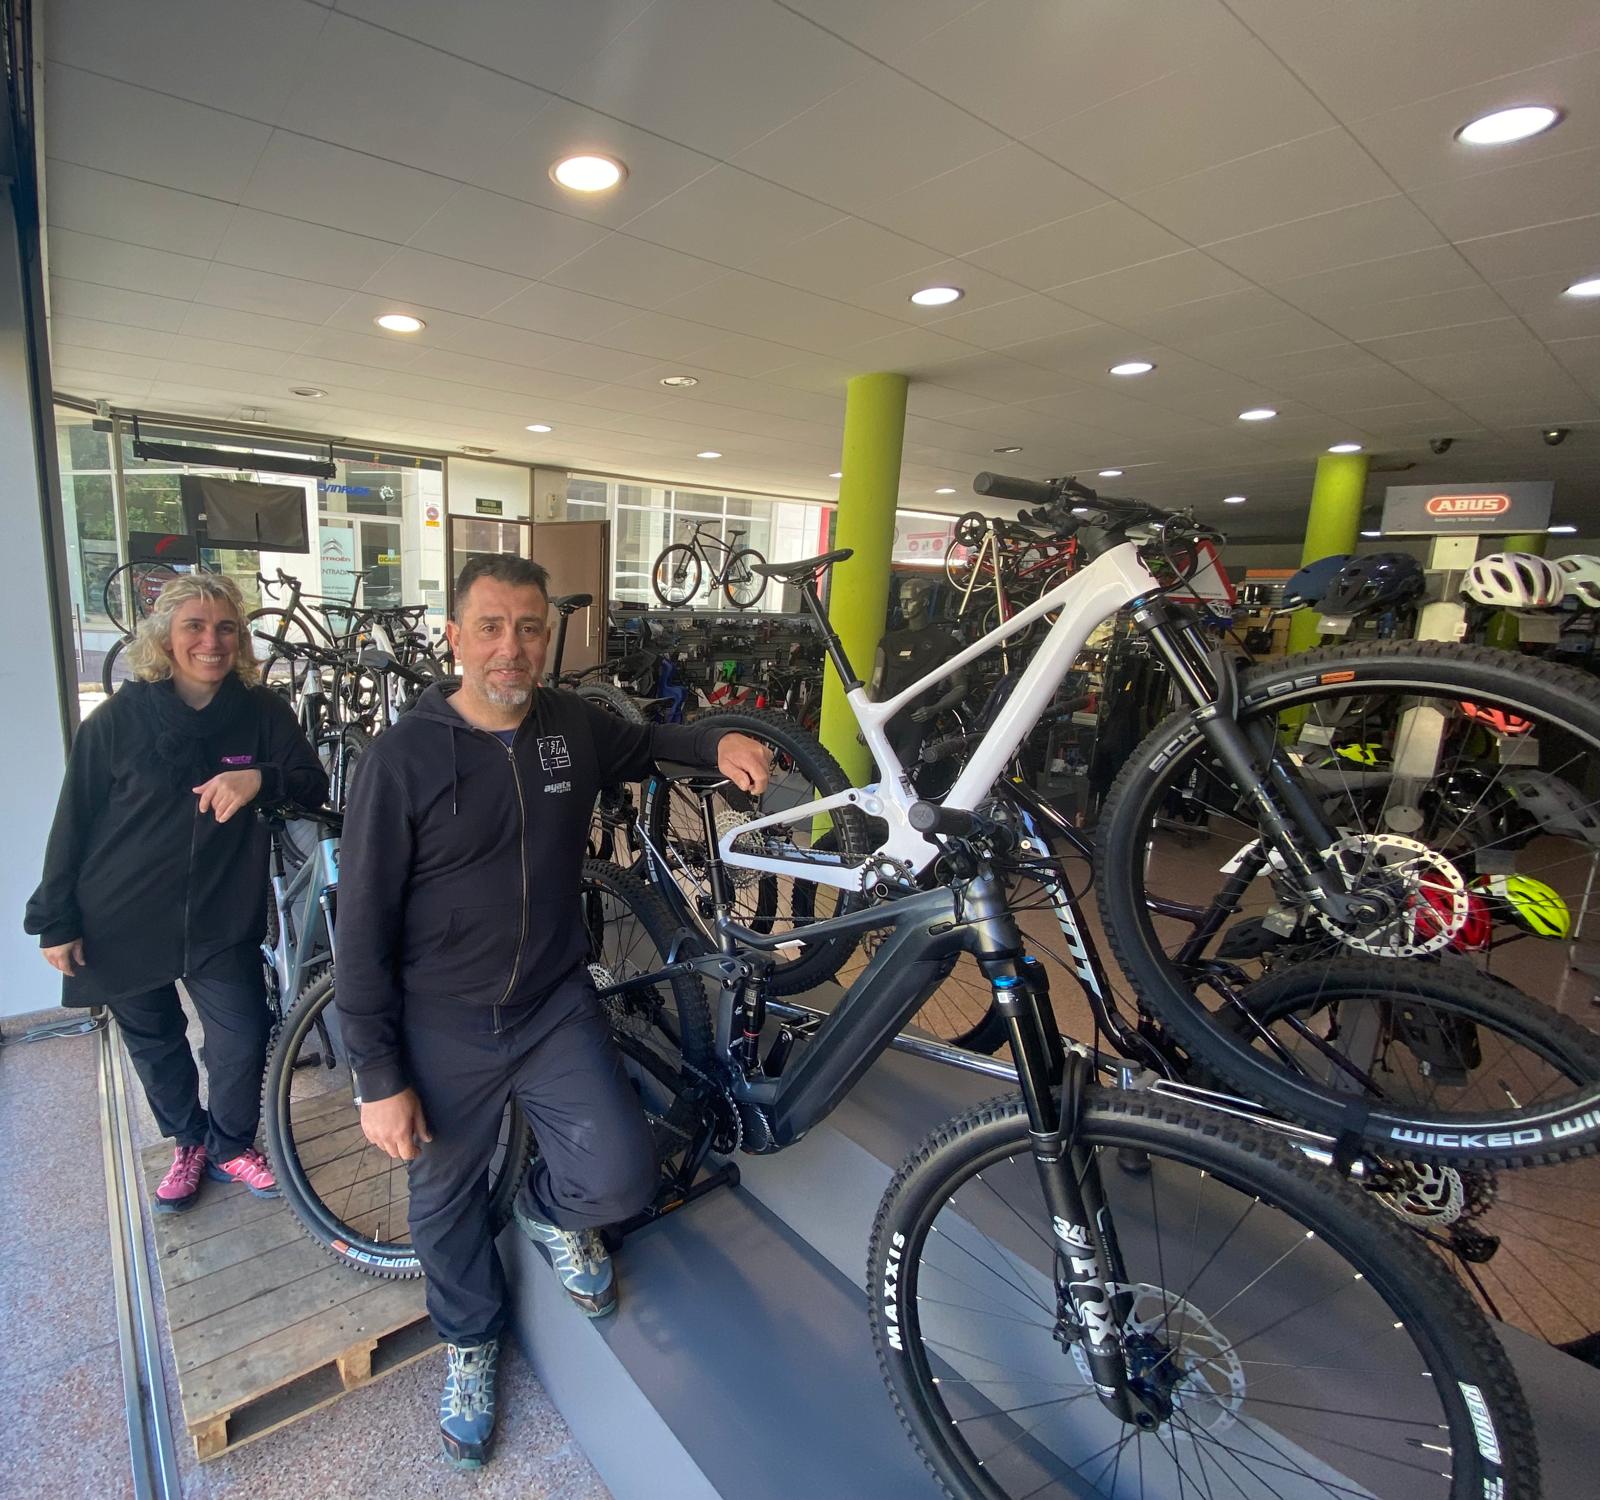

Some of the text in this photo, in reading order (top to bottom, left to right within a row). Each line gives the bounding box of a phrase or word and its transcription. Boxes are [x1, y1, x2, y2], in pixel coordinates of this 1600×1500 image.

[1437, 499, 1500, 511] ABUS
[1390, 1127, 1543, 1148] WICKED
[883, 1231, 905, 1351] MAXXIS
